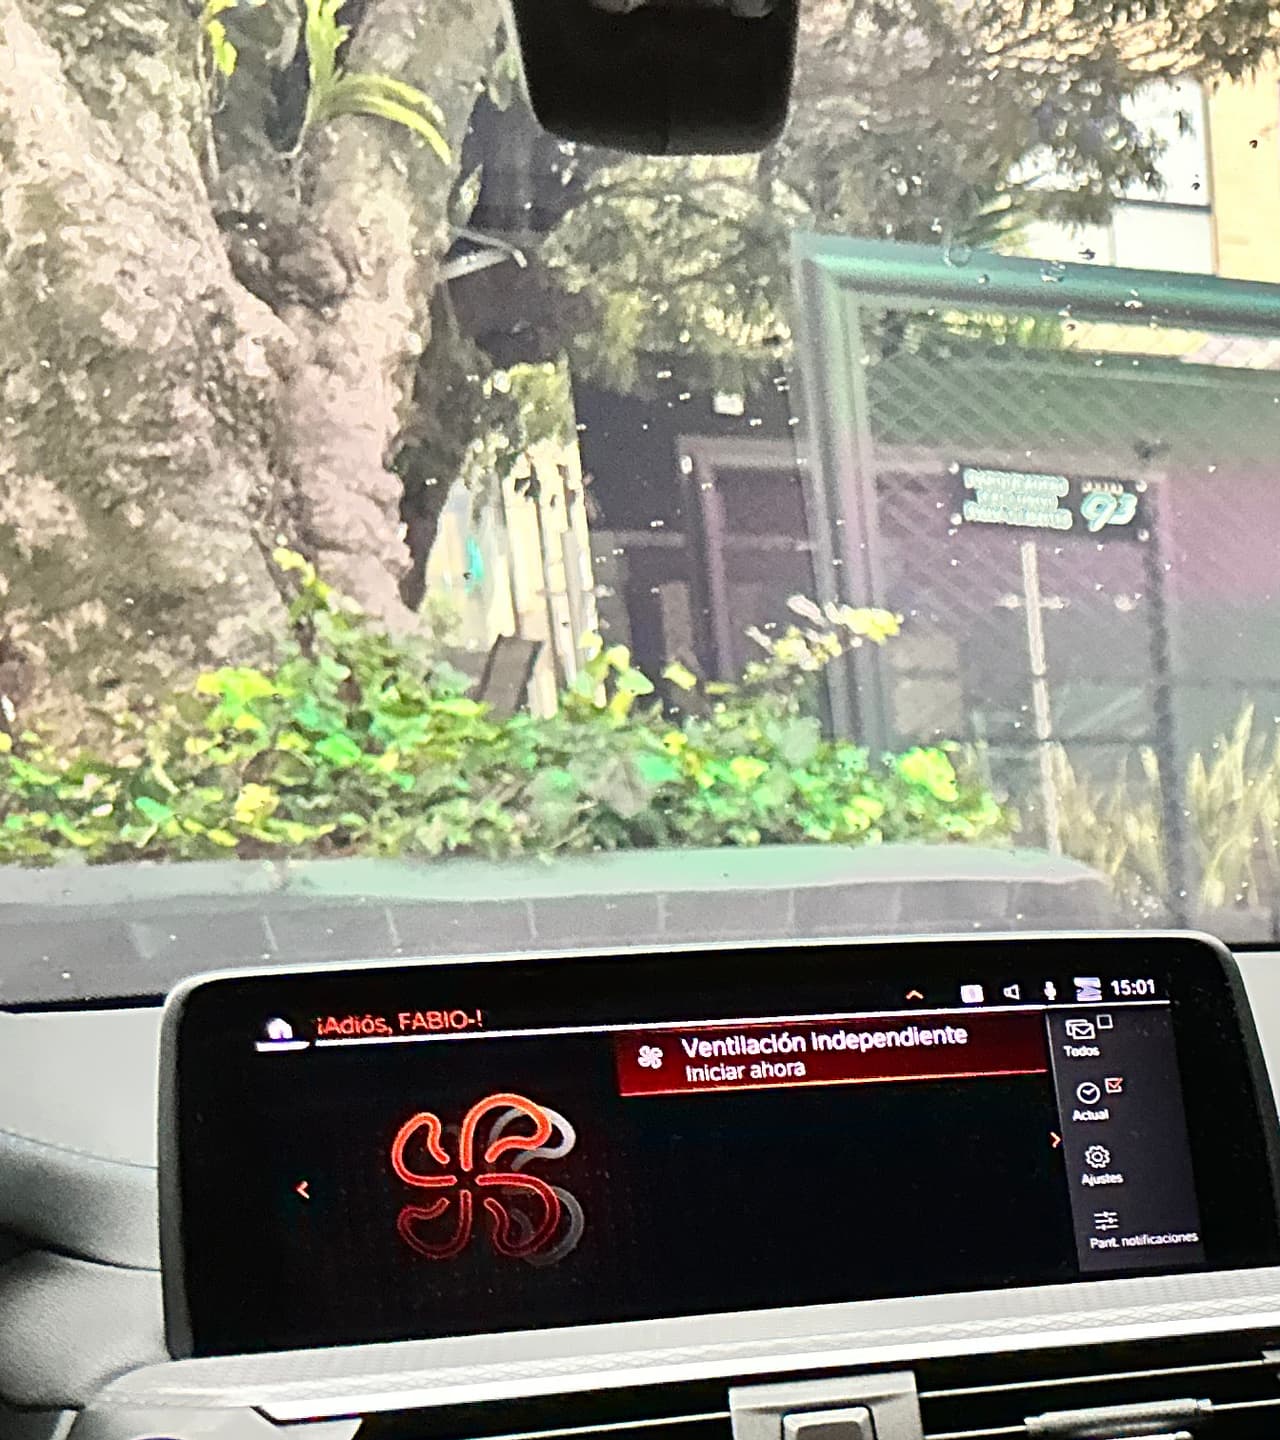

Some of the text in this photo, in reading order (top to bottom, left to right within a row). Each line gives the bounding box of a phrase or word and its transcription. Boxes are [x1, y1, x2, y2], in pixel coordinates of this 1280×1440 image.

[1080, 491, 1139, 532] 93
[1110, 979, 1156, 996] 15:01
[316, 1008, 484, 1036] ¡Adiós, FABIO-!
[681, 1031, 807, 1059] Ventilación
[1063, 1045, 1101, 1057] Todos
[685, 1060, 806, 1082] Iniciar ahora
[1072, 1108, 1110, 1122] Actual
[1081, 1173, 1124, 1187] Ajustes
[1090, 1232, 1199, 1249] Pant. notificaciones
